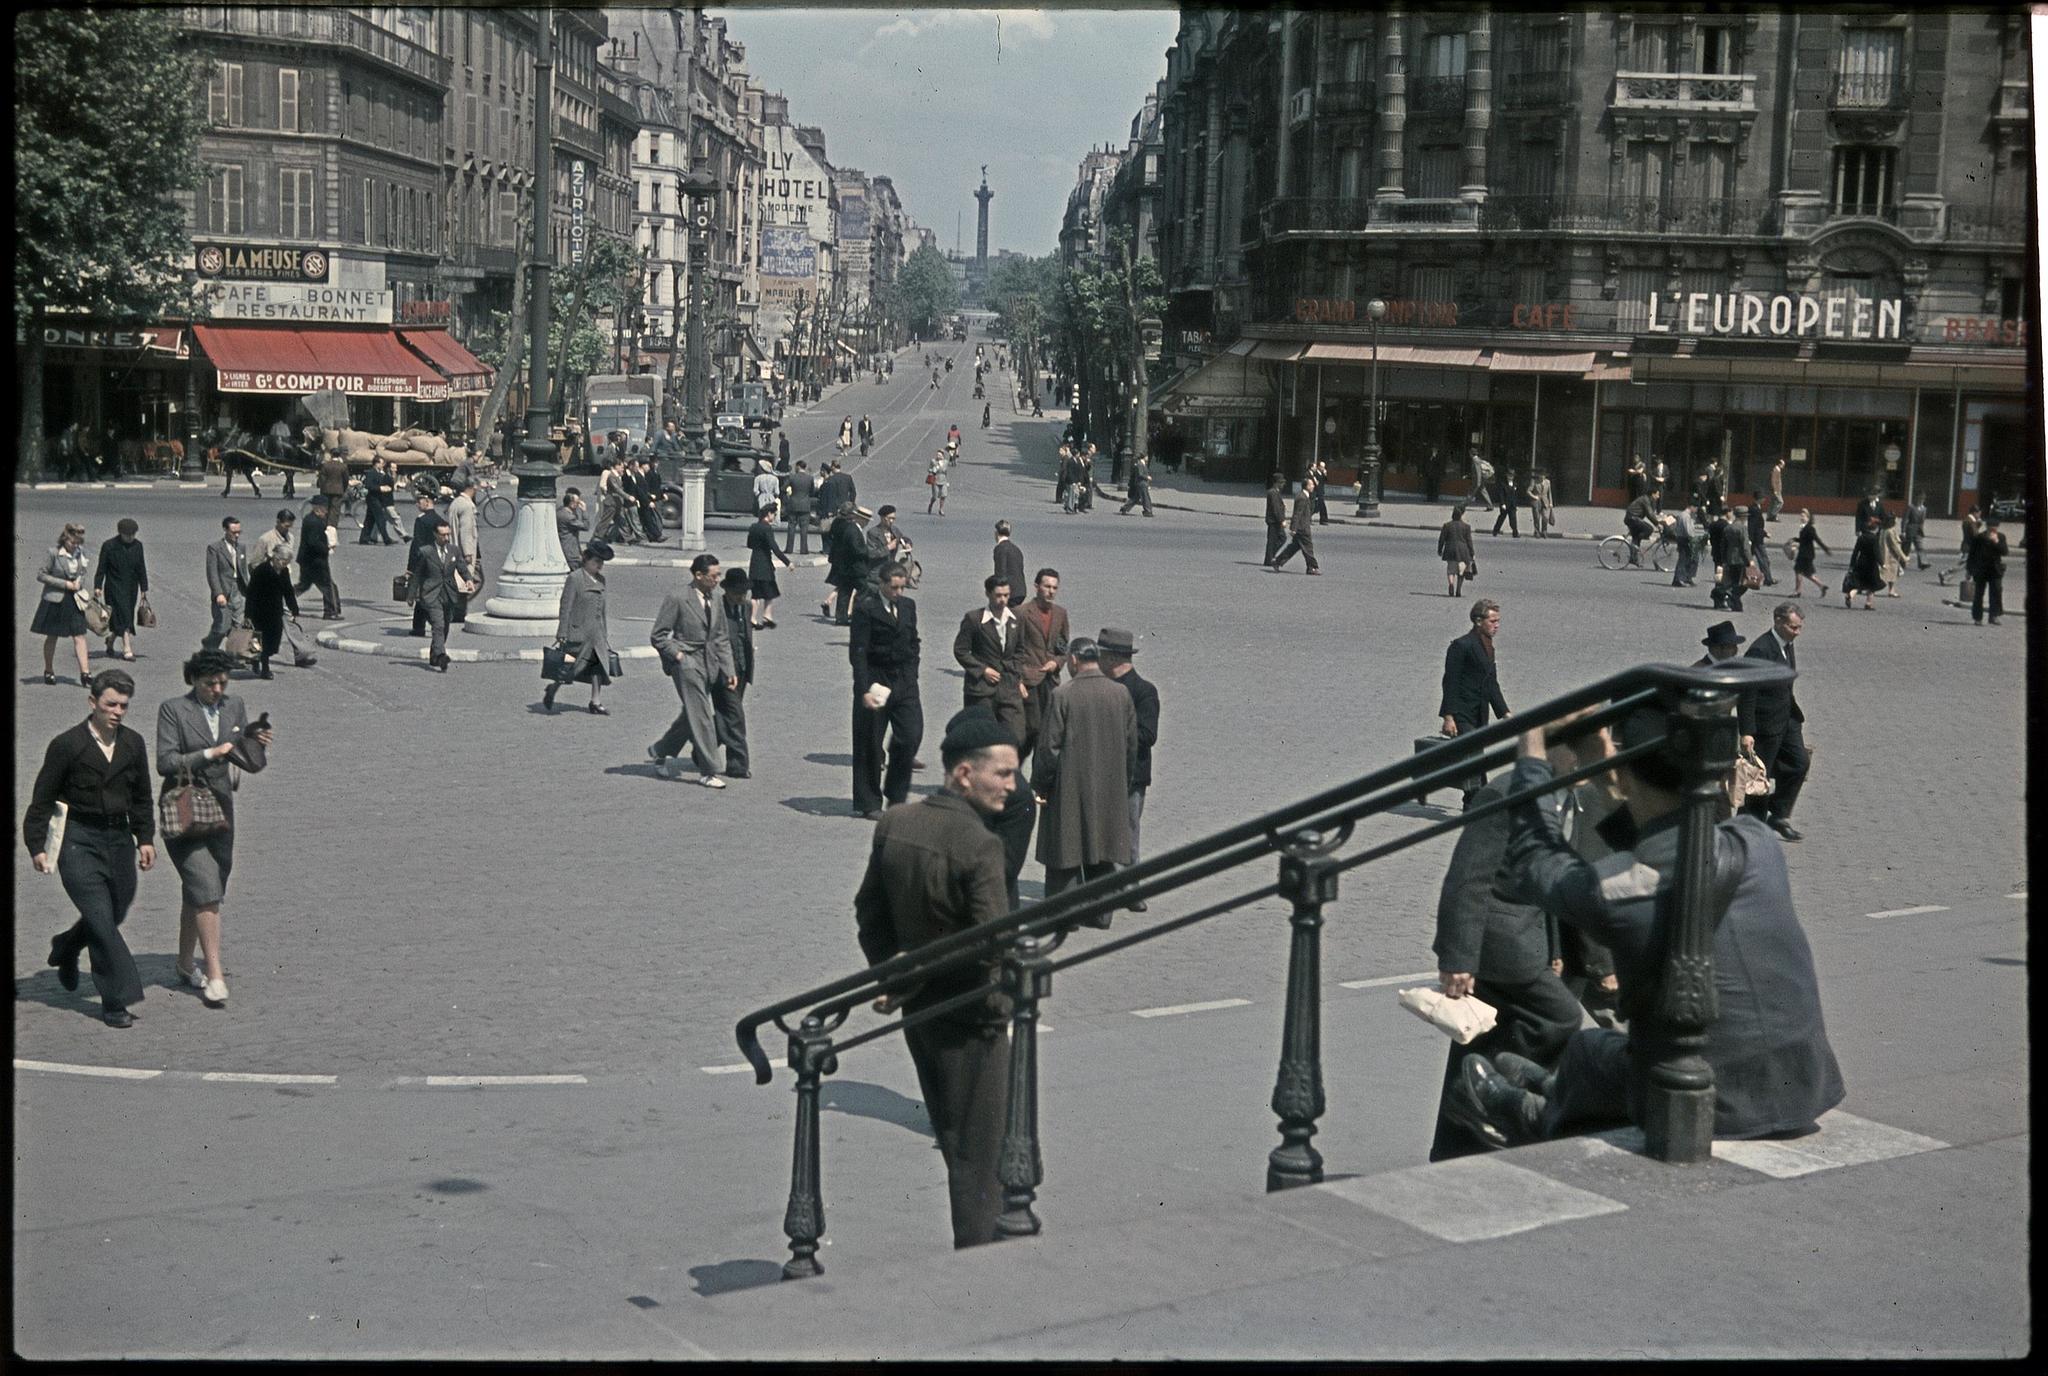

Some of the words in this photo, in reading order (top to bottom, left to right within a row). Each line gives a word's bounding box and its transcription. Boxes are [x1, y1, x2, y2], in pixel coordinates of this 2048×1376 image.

[572, 160, 584, 210] AZUR
[764, 178, 827, 199] HOTEL
[571, 213, 583, 268] HOTE
[225, 247, 247, 269] LA
[250, 249, 300, 272] MEUSE
[307, 289, 387, 306] BONNET
[236, 303, 367, 321] RESTAURANT
[43, 328, 158, 346] ONNET
[276, 374, 363, 391] COMPTOIR
